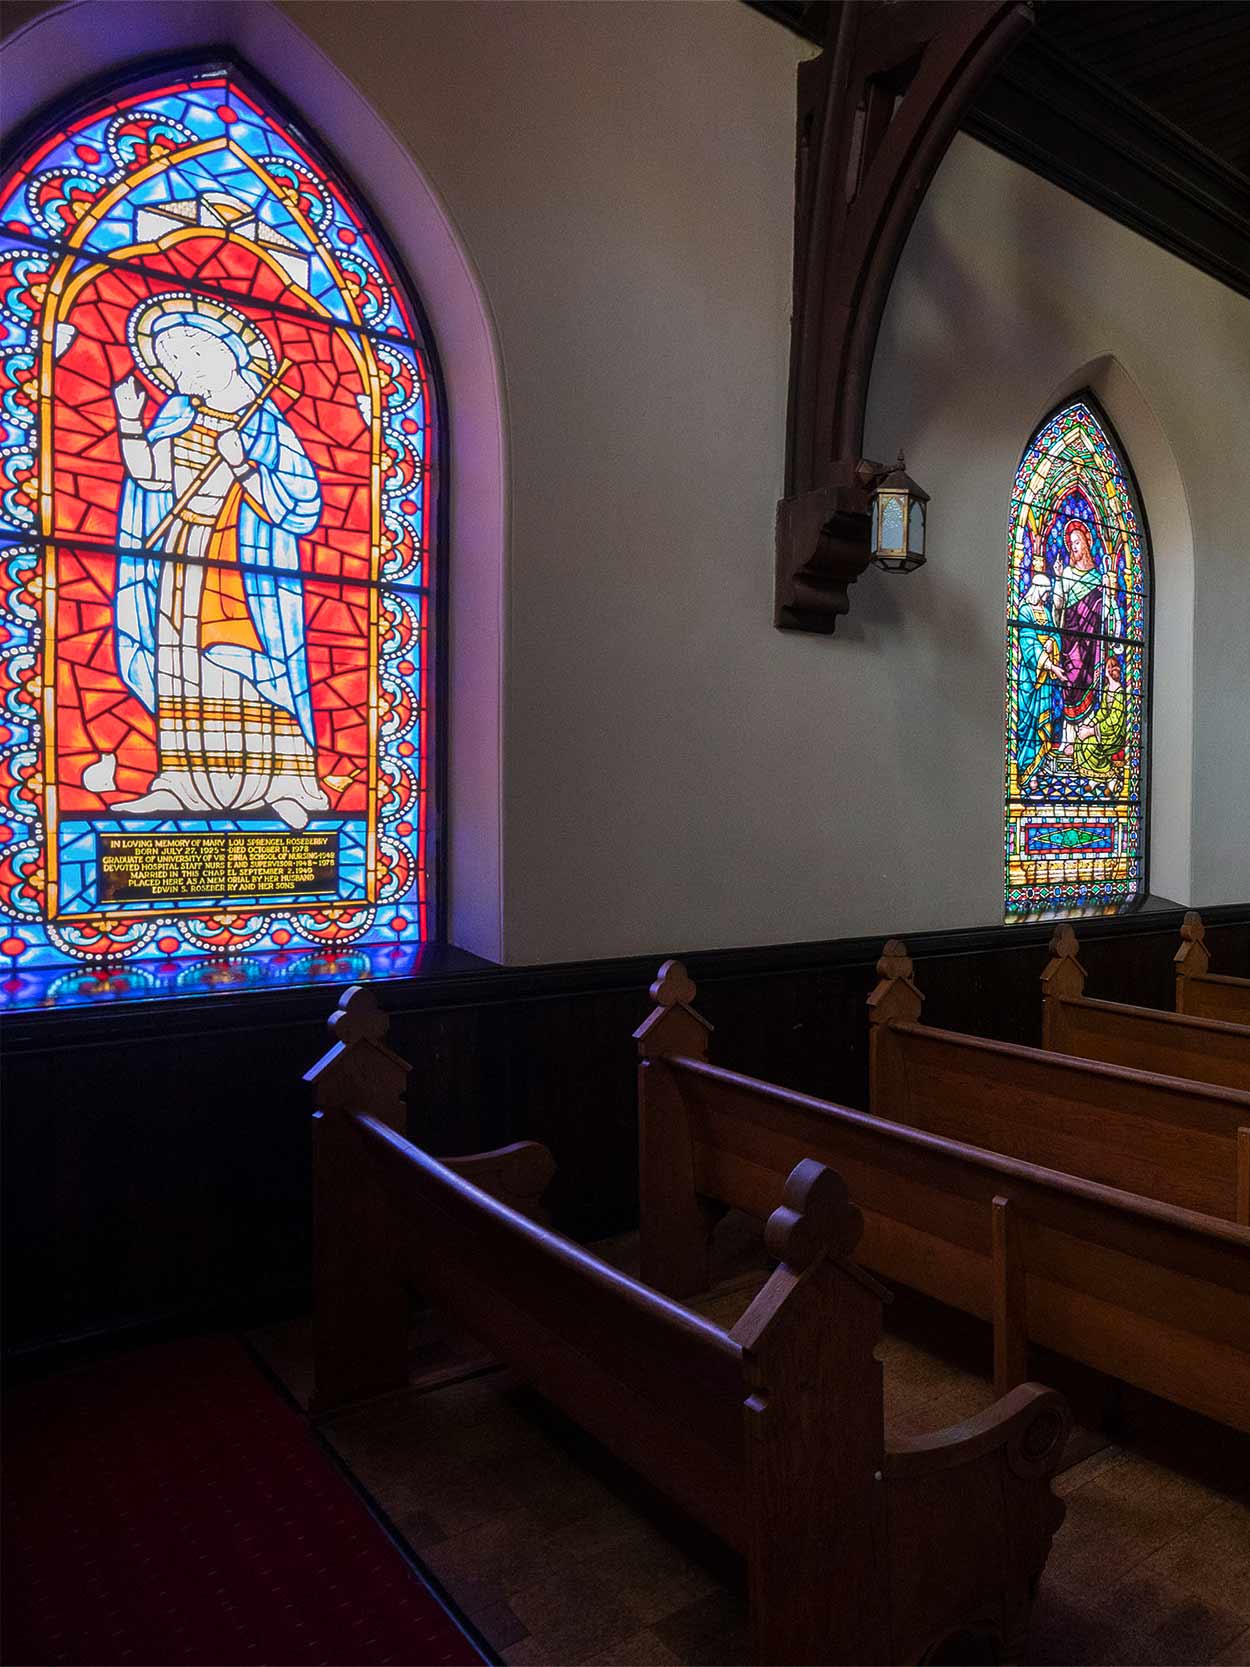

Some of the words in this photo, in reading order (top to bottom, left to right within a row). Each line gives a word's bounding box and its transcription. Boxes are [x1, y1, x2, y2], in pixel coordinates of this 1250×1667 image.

[110, 840, 121, 848] IN
[122, 840, 153, 848] LOVING
[154, 839, 190, 848] MEMORY
[191, 839, 201, 847] OF
[202, 839, 225, 847] MARY
[228, 838, 245, 846] LOU
[247, 838, 285, 846] SPRENGEL
[161, 847, 183, 855] JULY
[102, 856, 143, 864] GRADUATE
[145, 855, 156, 863] OF
[157, 855, 202, 863] UNIVERSITY
[202, 854, 212, 862] OF
[103, 864, 140, 872] DEVOTED
[141, 863, 179, 871] HOSPITAL
[180, 862, 203, 870] STAFF
[130, 871, 168, 879] MARRIED
[239, 868, 284, 876] SEPTEMBER
[128, 879, 160, 887] PLACED
[162, 878, 184, 886] HERE
[186, 877, 198, 885] AS
[280, 874, 315, 882] HUSBAND
[151, 886, 178, 894] EDWIN
[239, 883, 256, 891] AND
[275, 882, 295, 890] SONS
